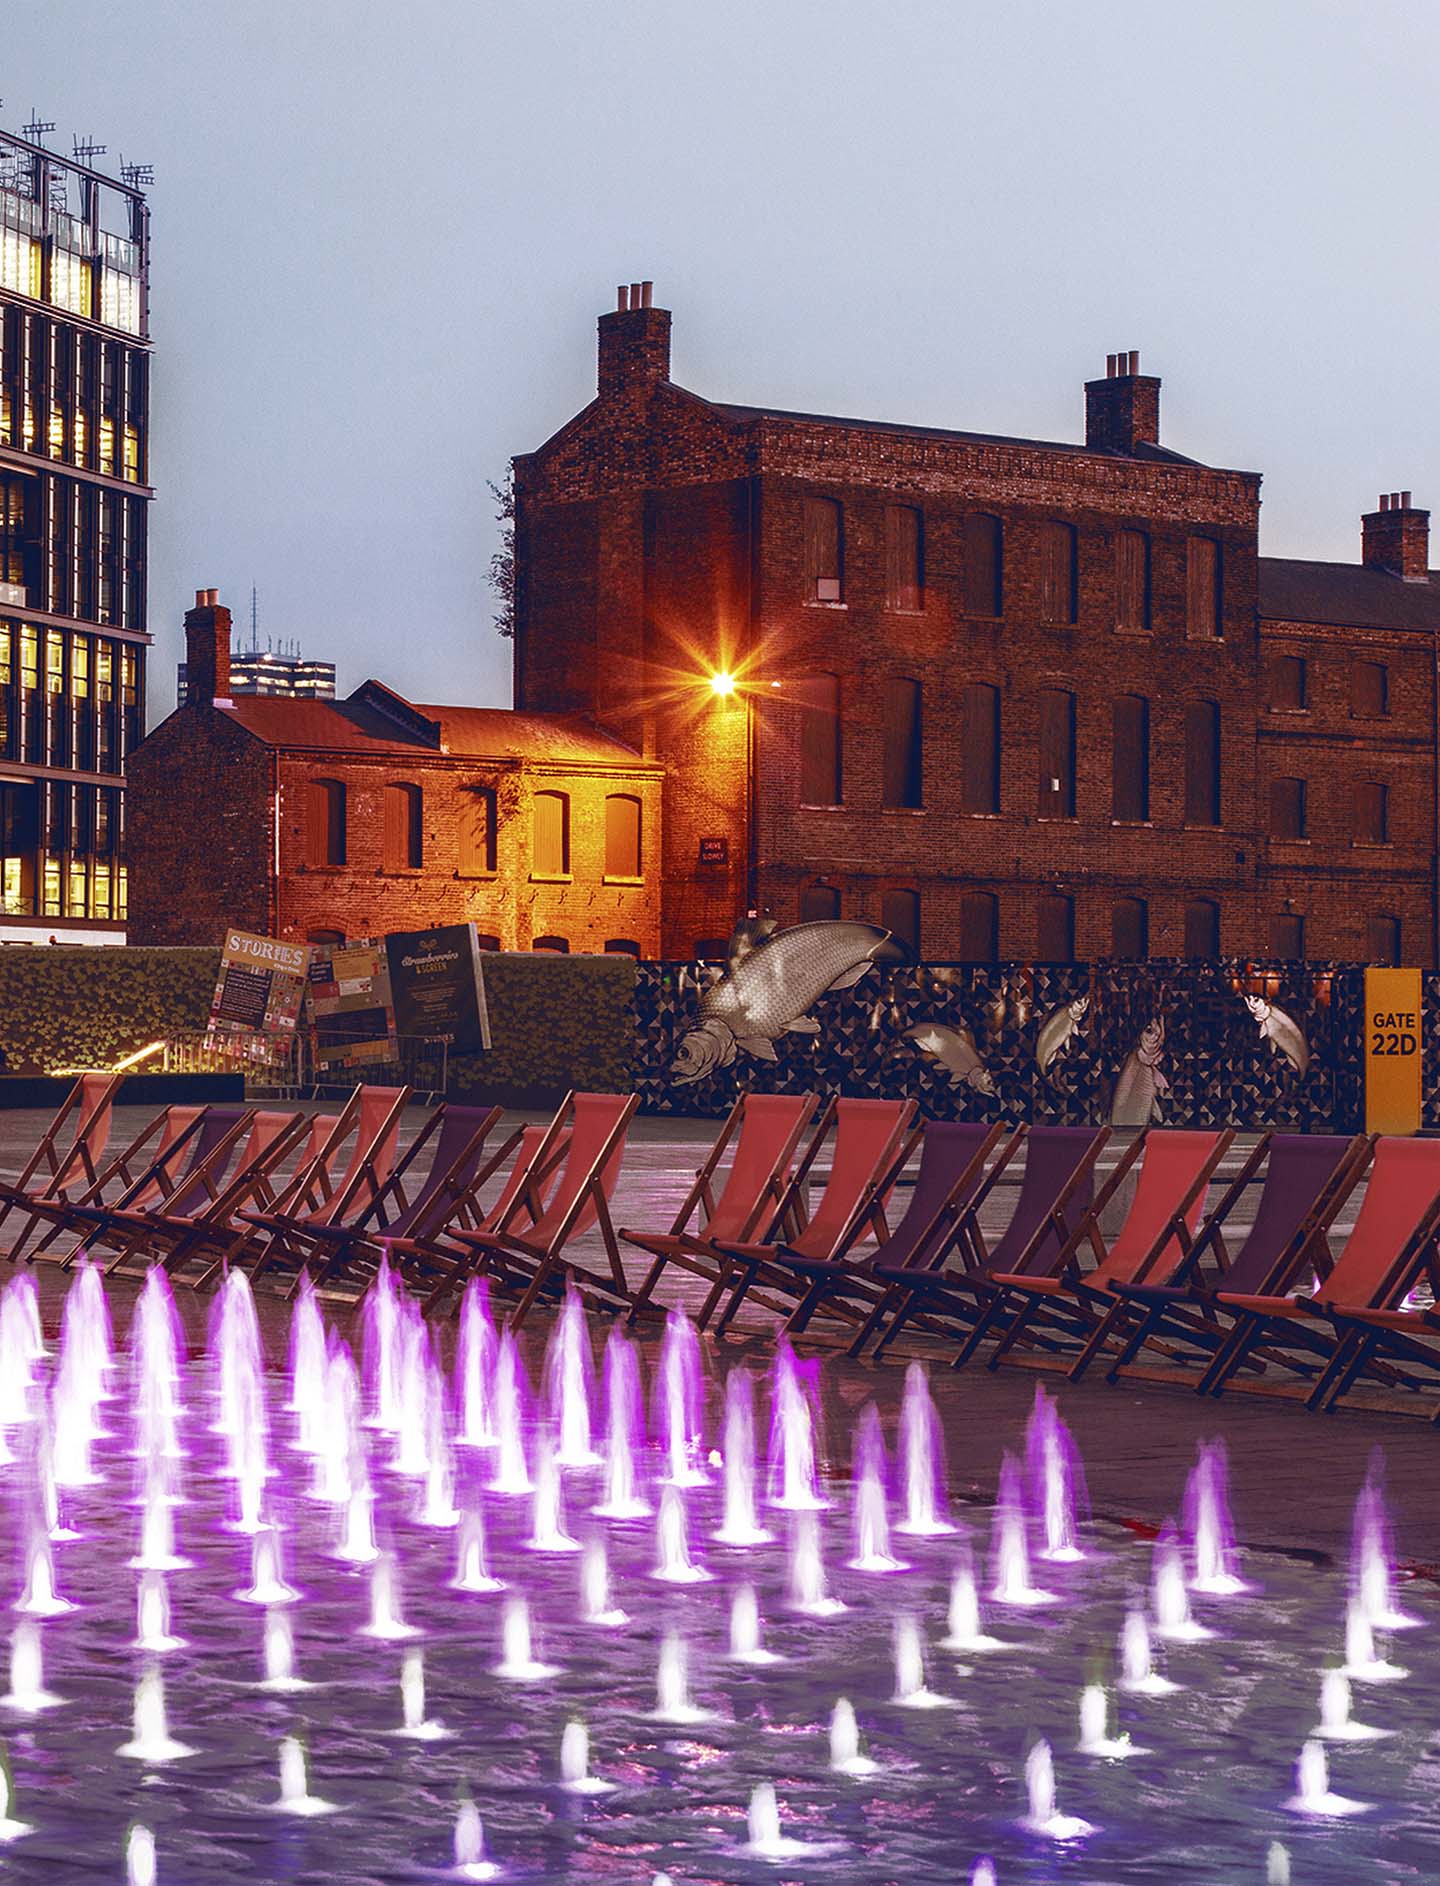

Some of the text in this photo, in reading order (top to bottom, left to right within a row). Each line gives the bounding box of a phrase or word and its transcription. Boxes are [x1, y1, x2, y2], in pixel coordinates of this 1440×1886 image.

[228, 935, 304, 966] STORIES
[1373, 1012, 1416, 1028] GATE
[1371, 1033, 1417, 1056] 22D
